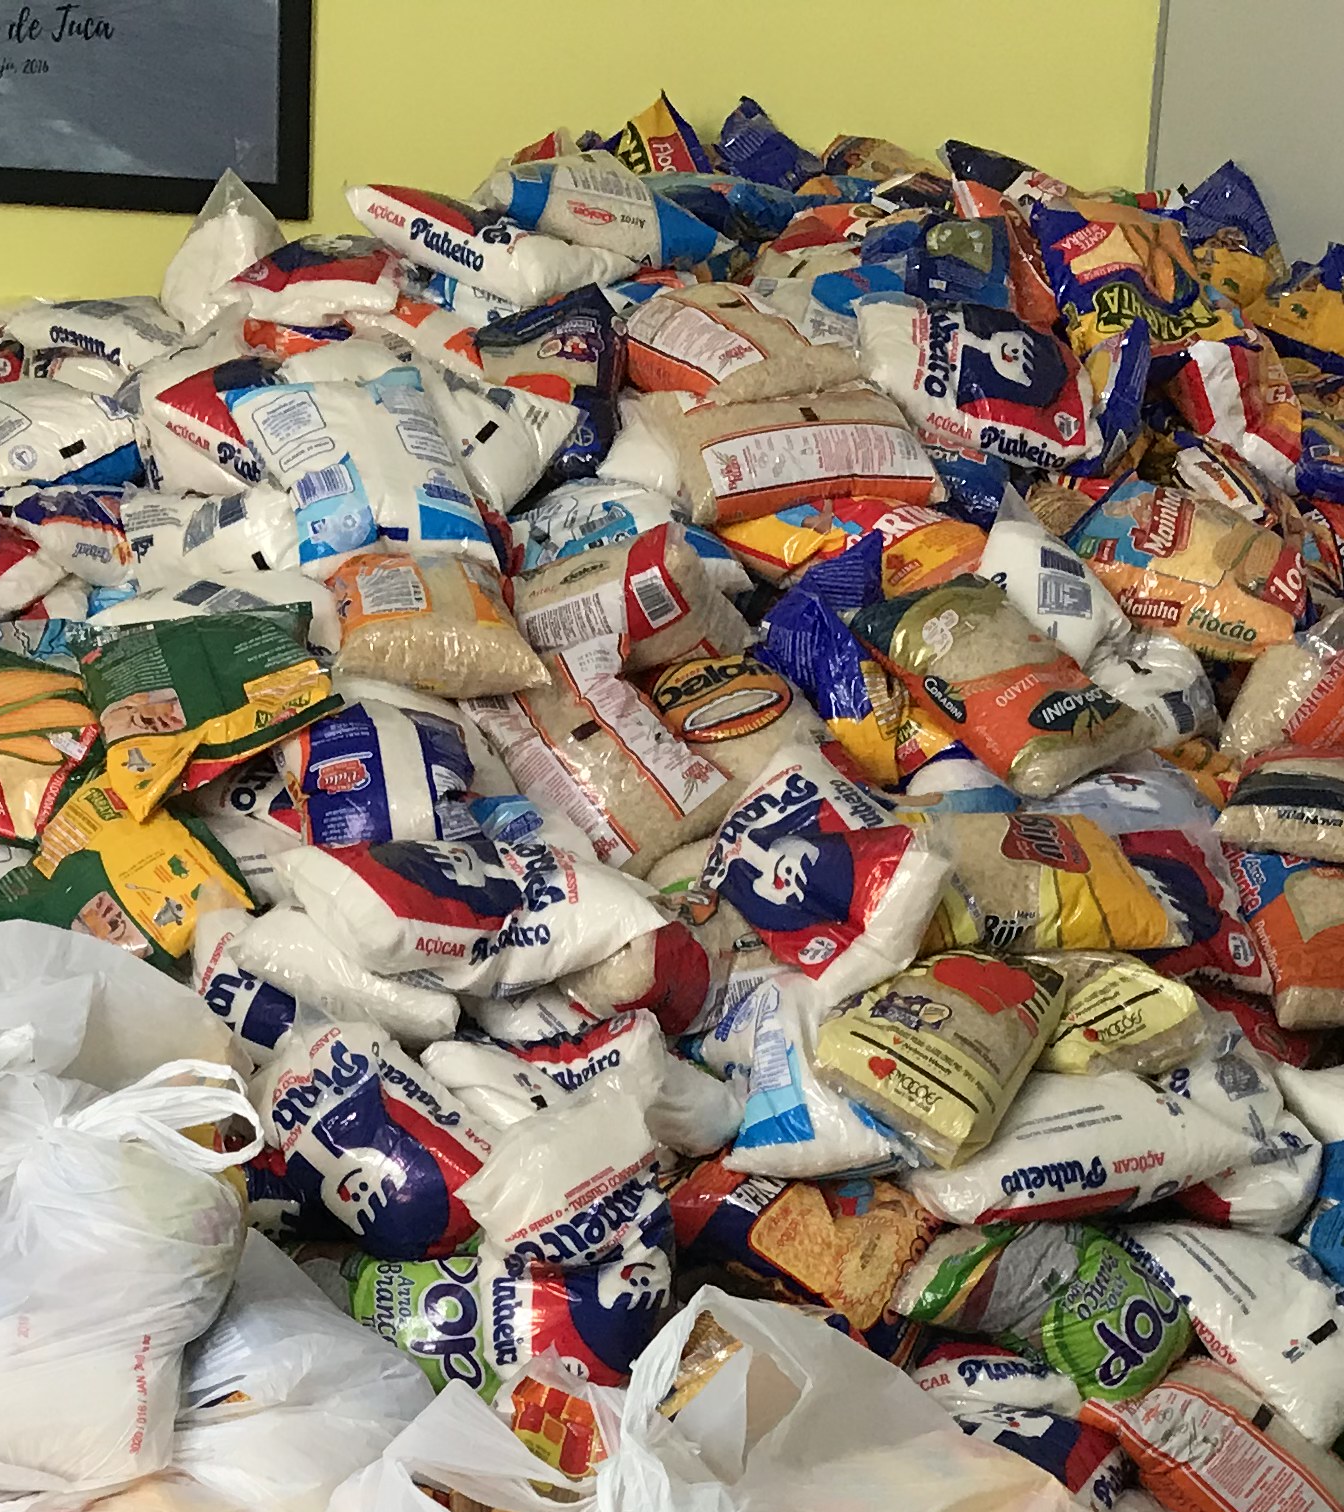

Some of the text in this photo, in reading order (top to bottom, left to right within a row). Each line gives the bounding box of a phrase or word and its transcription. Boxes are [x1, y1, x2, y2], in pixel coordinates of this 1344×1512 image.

[8, 14, 42, 41] de
[22, 58, 49, 74] 2016
[367, 202, 484, 272] AÇÚCAR Pinheiro
[1061, 227, 1091, 249] FIBRA
[1081, 228, 1107, 250] FONTE
[164, 419, 211, 452] AÇÚCAR
[217, 440, 264, 482] Pinh
[926, 411, 1065, 471] AÇÚCAR Pinheiro
[1119, 594, 1258, 642] Mainha Flocão
[925, 678, 963, 719] CORADINI
[415, 936, 466, 958] AÇÚCAR
[1000, 1155, 1108, 1197] Pinheiro
[1111, 1151, 1165, 1175] AÇÚCAR
[1191, 1316, 1237, 1365] AÇÚCAR
[136, 1375, 147, 1396] JAN
